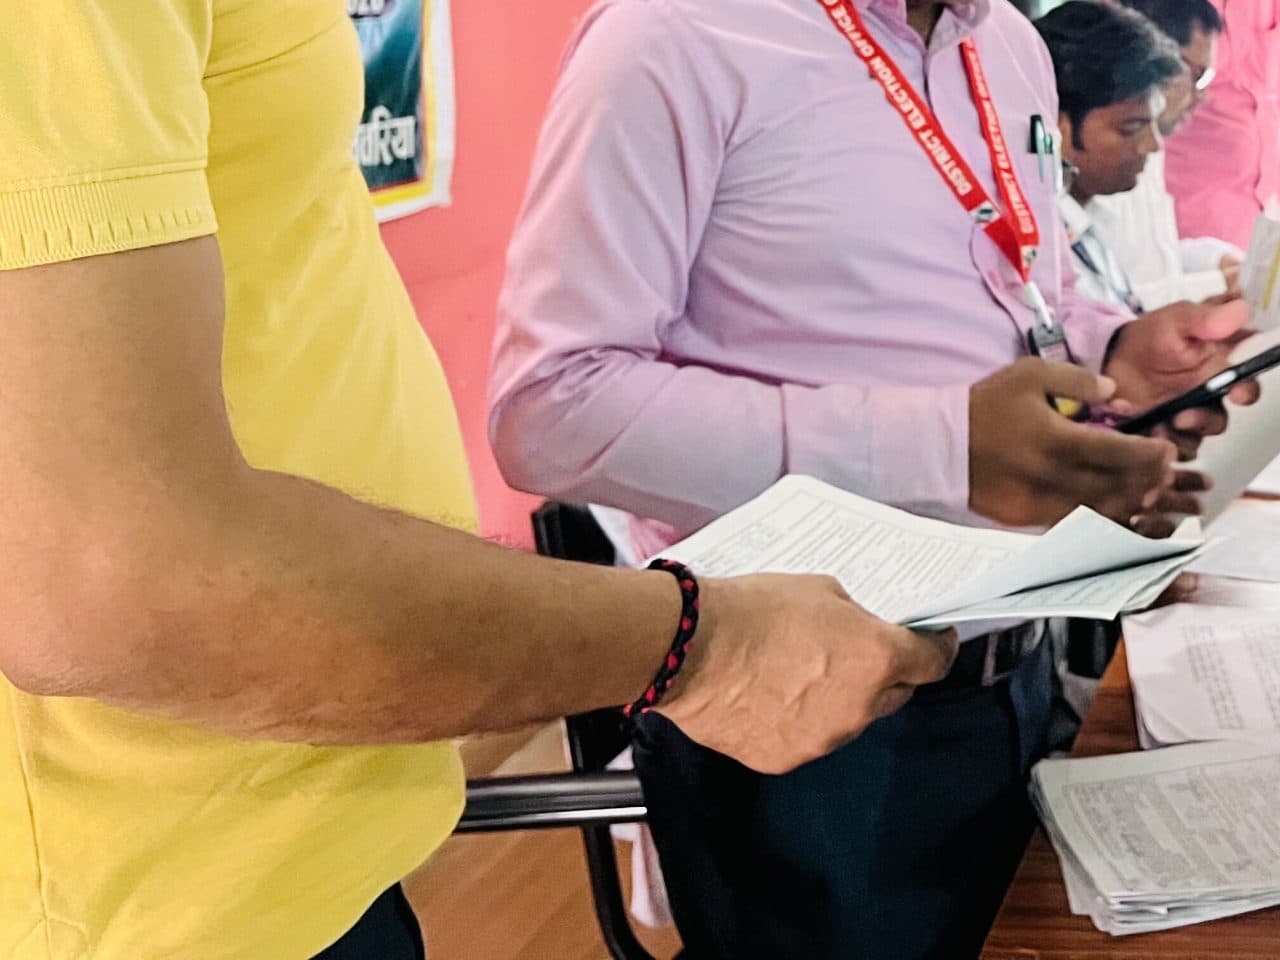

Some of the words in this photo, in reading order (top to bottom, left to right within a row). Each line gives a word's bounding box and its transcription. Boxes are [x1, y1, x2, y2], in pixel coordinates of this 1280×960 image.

[831, 3, 875, 60] OFFICE
[867, 54, 927, 131] ELECTION
[918, 126, 974, 196] DISTRICT
